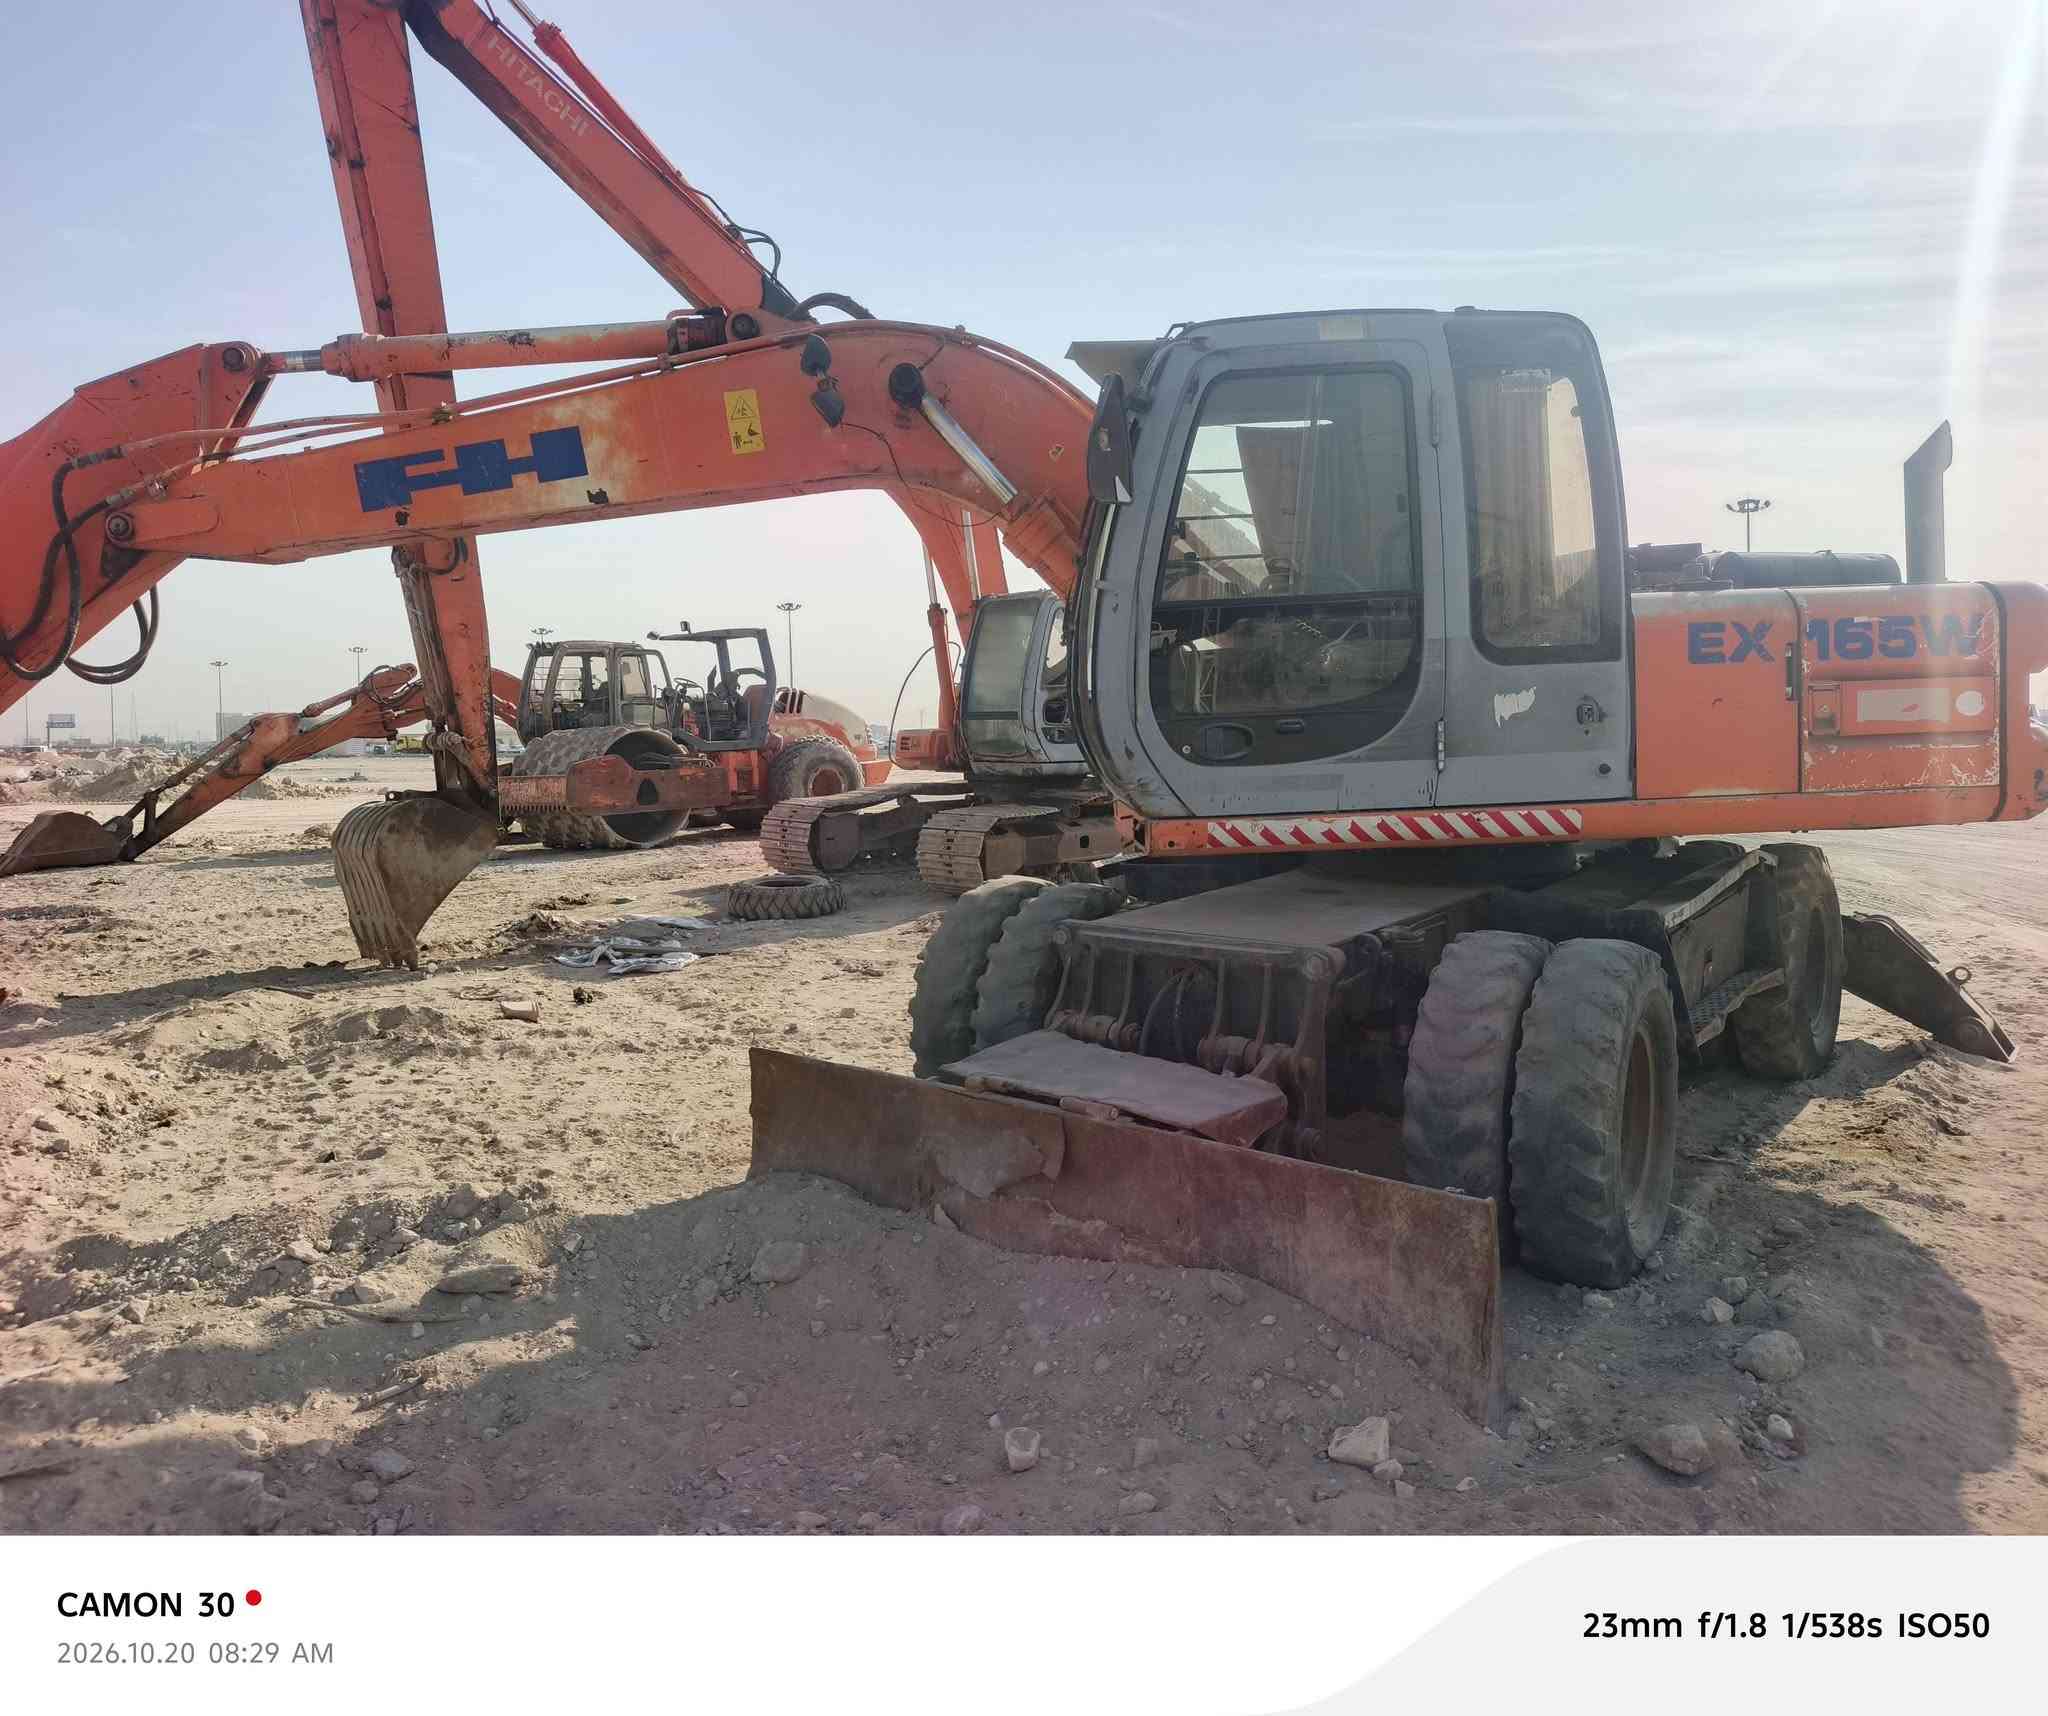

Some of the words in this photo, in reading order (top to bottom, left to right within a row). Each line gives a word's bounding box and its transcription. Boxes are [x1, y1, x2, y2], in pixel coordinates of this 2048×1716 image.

[488, 34, 588, 137] HITACHI
[1687, 621, 1776, 665] EX
[1806, 613, 1987, 663] 165W
